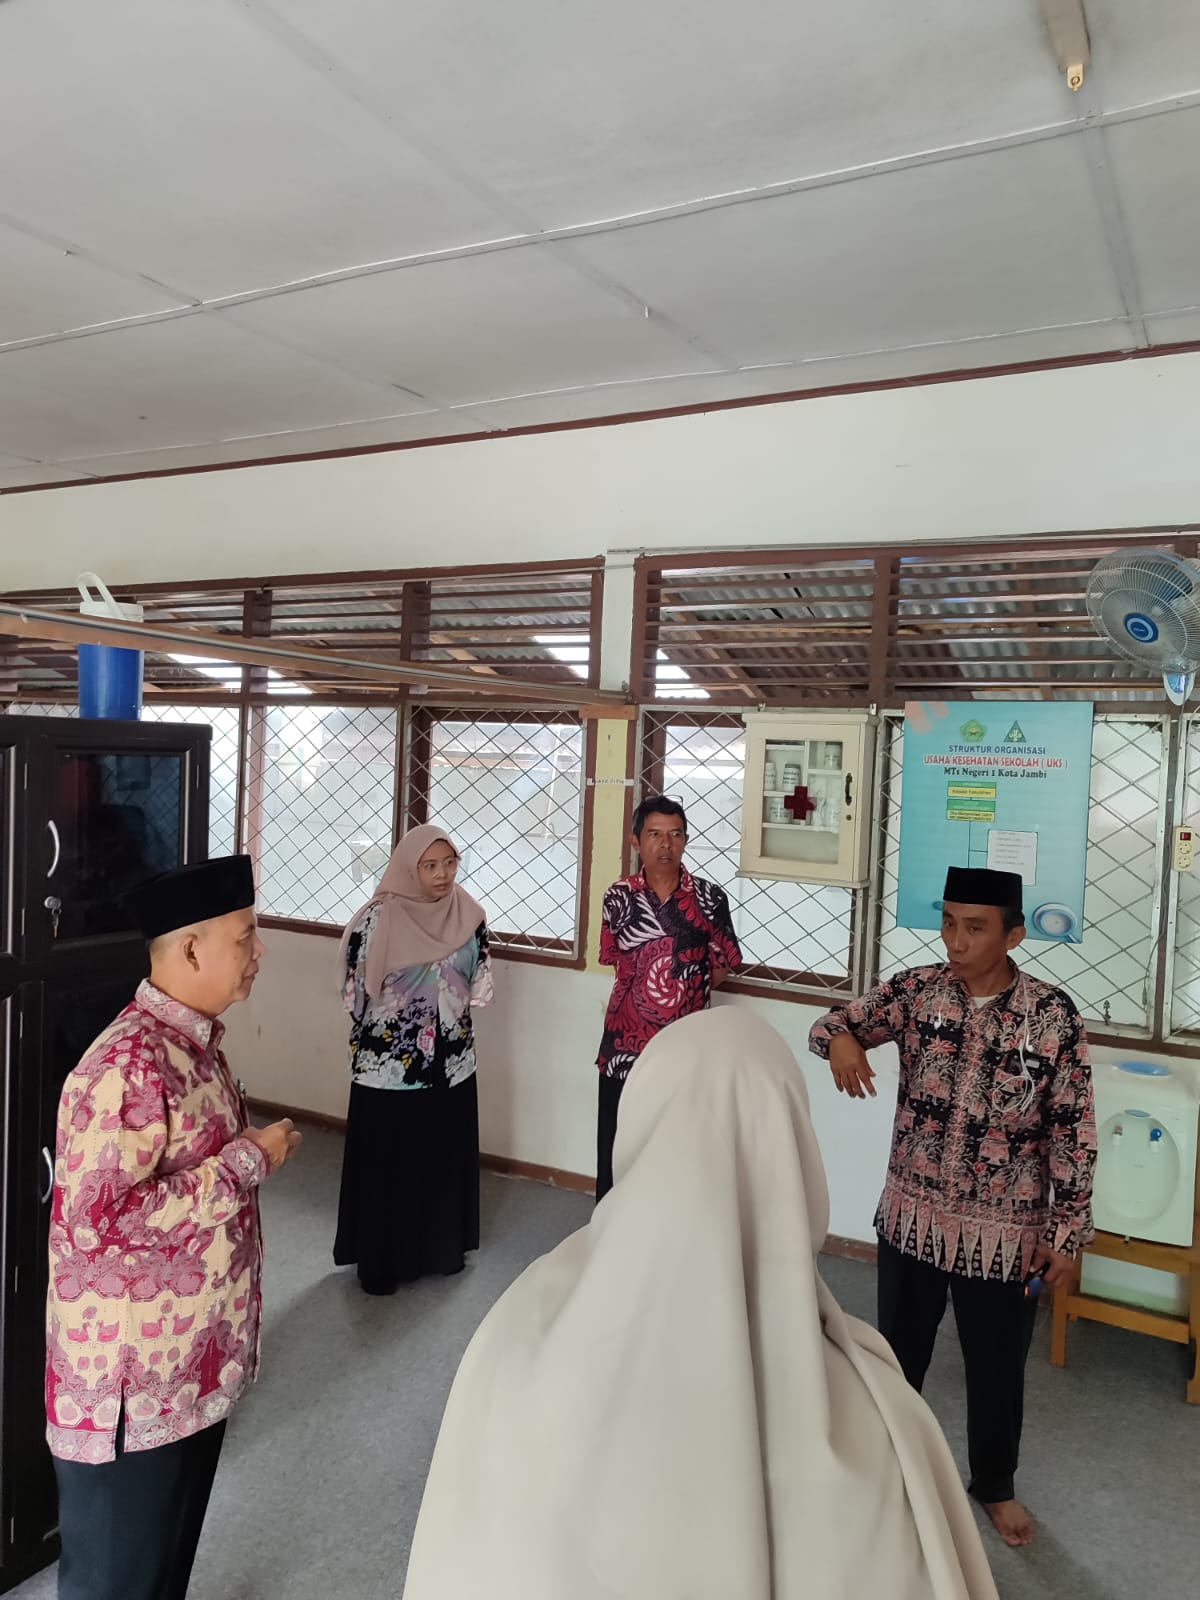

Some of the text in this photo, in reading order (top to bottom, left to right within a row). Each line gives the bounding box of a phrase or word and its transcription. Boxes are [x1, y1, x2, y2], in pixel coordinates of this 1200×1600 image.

[948, 744, 1046, 755] STRUKTUR ORGANISASI
[924, 755, 951, 765] USAHA
[952, 755, 999, 766] KESEHATAN
[1001, 756, 1039, 768] SEKOLAH
[944, 767, 960, 776] MTs
[962, 767, 989, 778] Negeri
[998, 768, 1019, 778] Kota
[1020, 768, 1047, 779] Jambi
